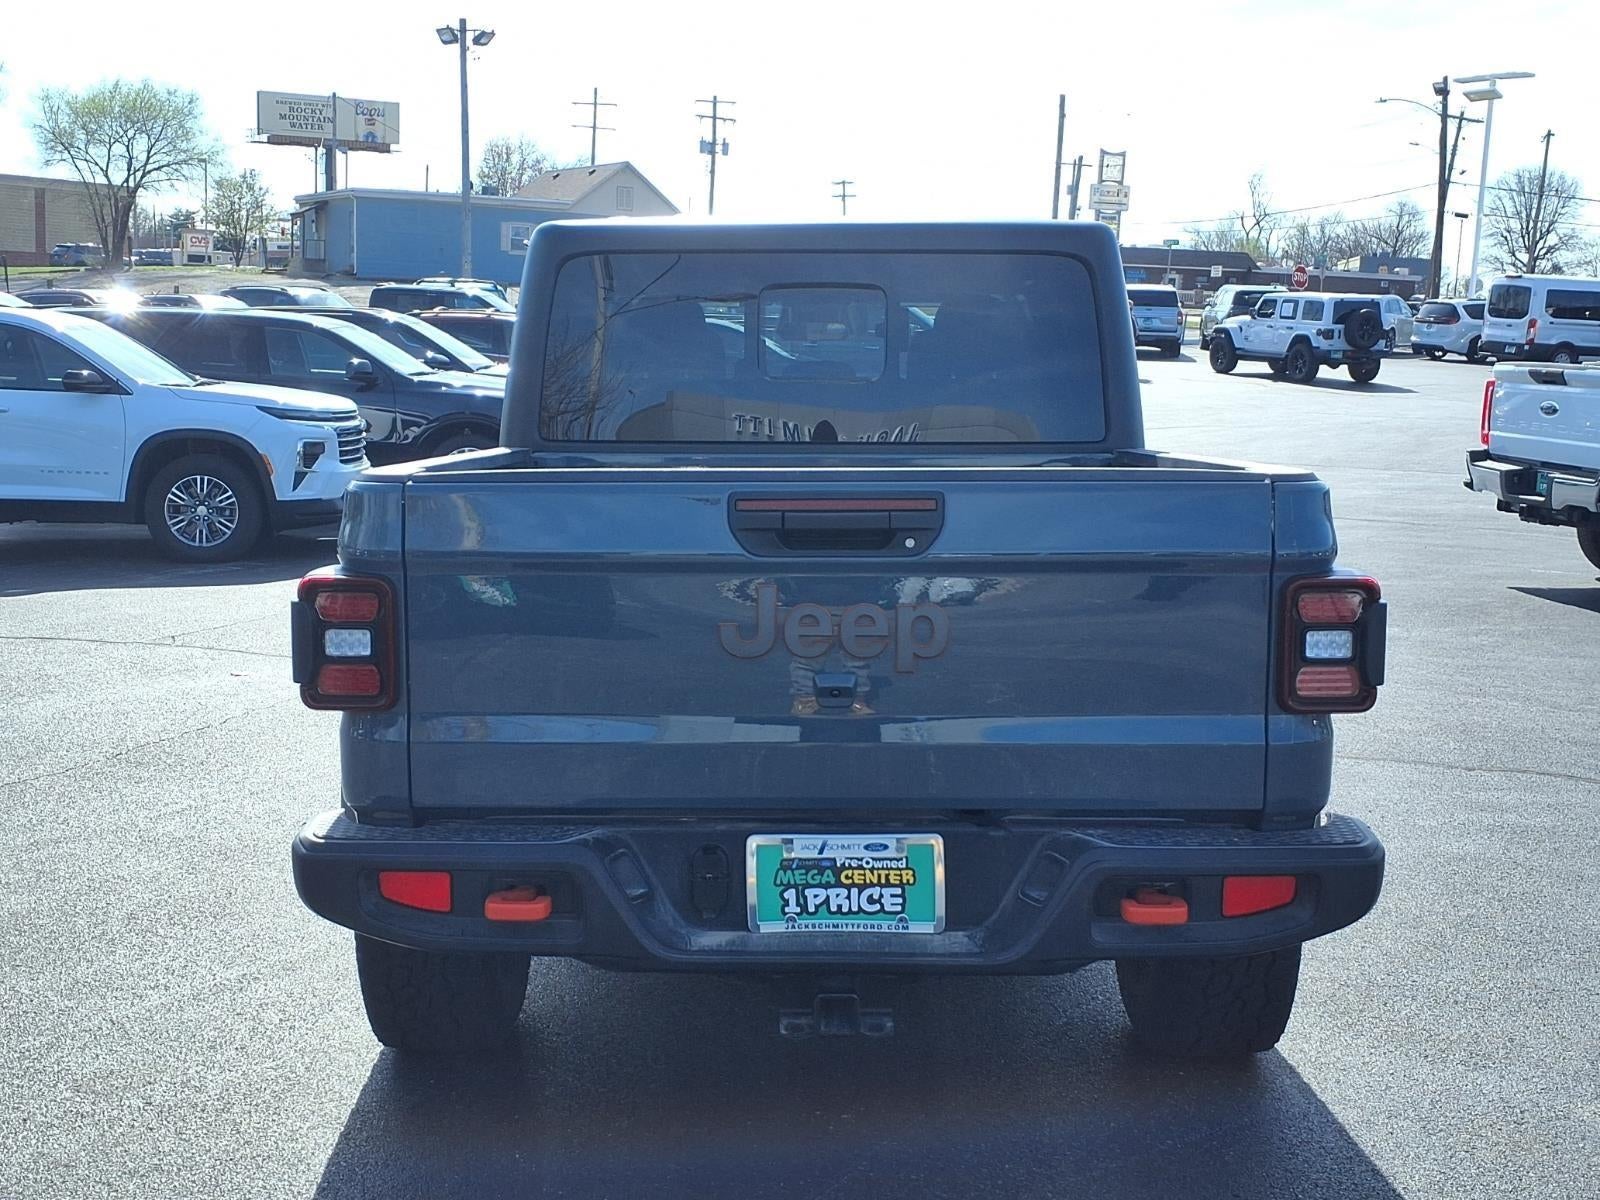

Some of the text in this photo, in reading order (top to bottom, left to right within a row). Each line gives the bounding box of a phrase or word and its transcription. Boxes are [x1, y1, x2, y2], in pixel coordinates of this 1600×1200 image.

[288, 106, 324, 115] ROCKY
[355, 101, 385, 118] Coors
[279, 113, 334, 124] MOUNTAIN
[289, 122, 324, 131] WATER
[190, 236, 210, 245] CVS
[1293, 271, 1308, 282] STOP
[718, 584, 949, 674] Jeep
[826, 843, 861, 851] SCHMITT
[835, 857, 907, 868] Pre-Owned
[775, 869, 915, 885] MEGA CENTER
[783, 886, 903, 913] 1 PRICE
[784, 922, 910, 931] JACKSCHMITTFORD.COM
